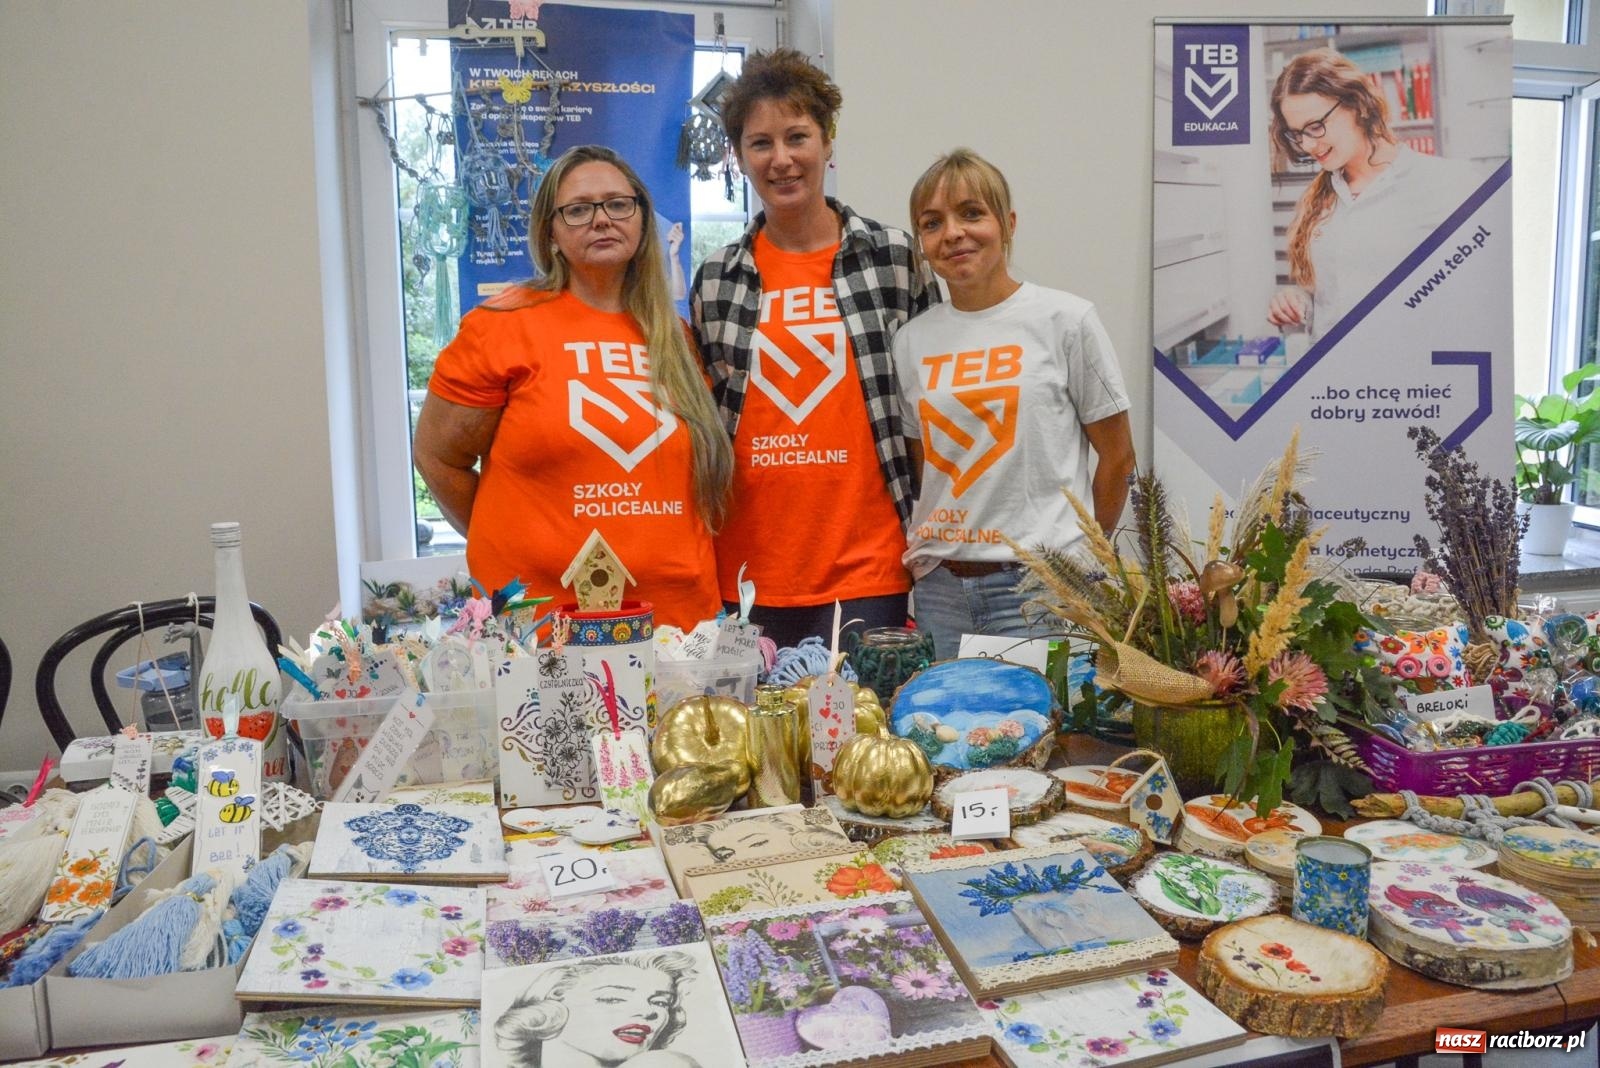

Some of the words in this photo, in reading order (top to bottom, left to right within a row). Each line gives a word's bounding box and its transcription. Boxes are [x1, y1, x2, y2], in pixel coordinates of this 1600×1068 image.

[1185, 44, 1238, 65] TEB
[470, 68, 481, 78] W
[565, 114, 582, 122] TEB
[1184, 122, 1239, 132] EDUKACJA
[1404, 225, 1491, 309] www.teb.pl
[921, 345, 1024, 391] TEB
[1356, 385, 1401, 402] chcę
[1407, 384, 1452, 399] mieć
[1311, 405, 1366, 423] dobry
[1372, 404, 1440, 419] zawód!
[752, 434, 809, 450] SZKOŁY
[751, 450, 848, 467] POLICEALNE
[573, 483, 642, 499] SZKOŁY
[574, 501, 683, 517] POLICEALNE
